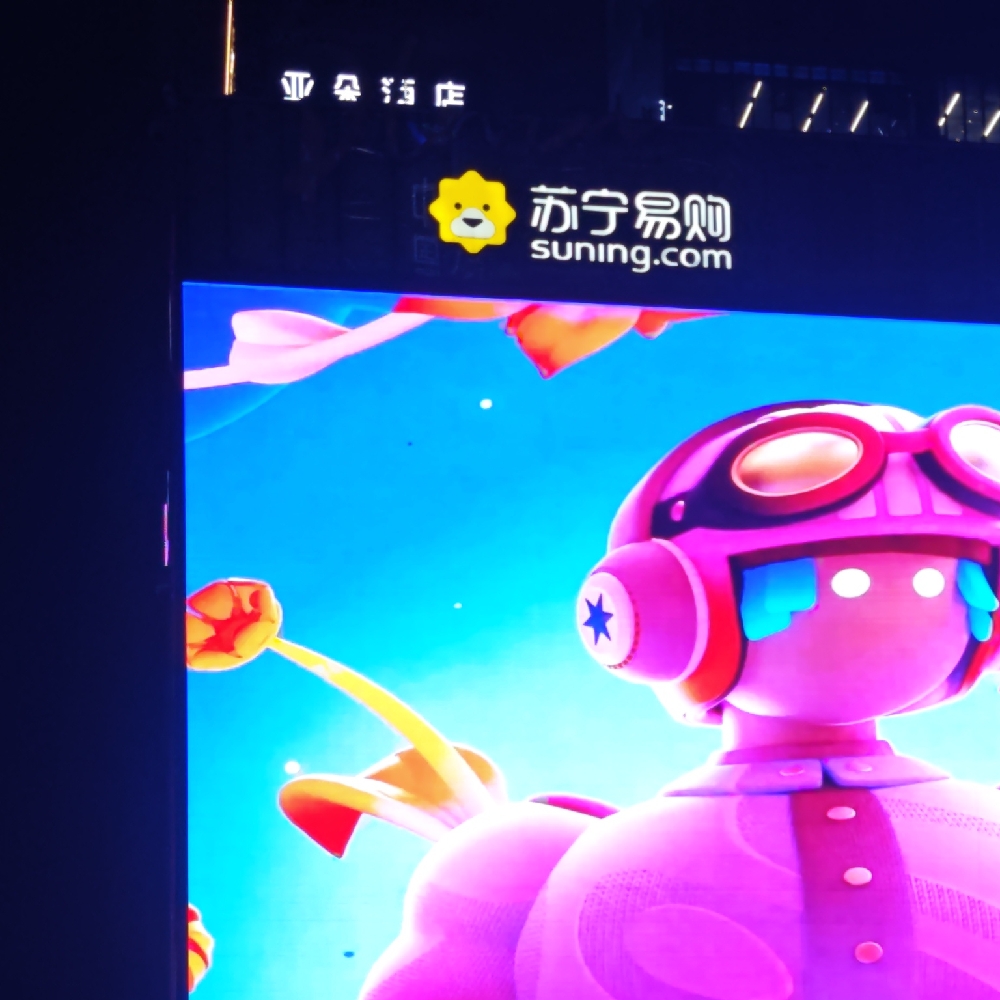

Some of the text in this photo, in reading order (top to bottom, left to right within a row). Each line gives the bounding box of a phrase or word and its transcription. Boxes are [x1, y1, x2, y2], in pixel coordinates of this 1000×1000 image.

[281, 70, 466, 107] 亚朵酒店
[531, 184, 732, 243] 苏宁易购
[531, 238, 732, 273] suning.com
